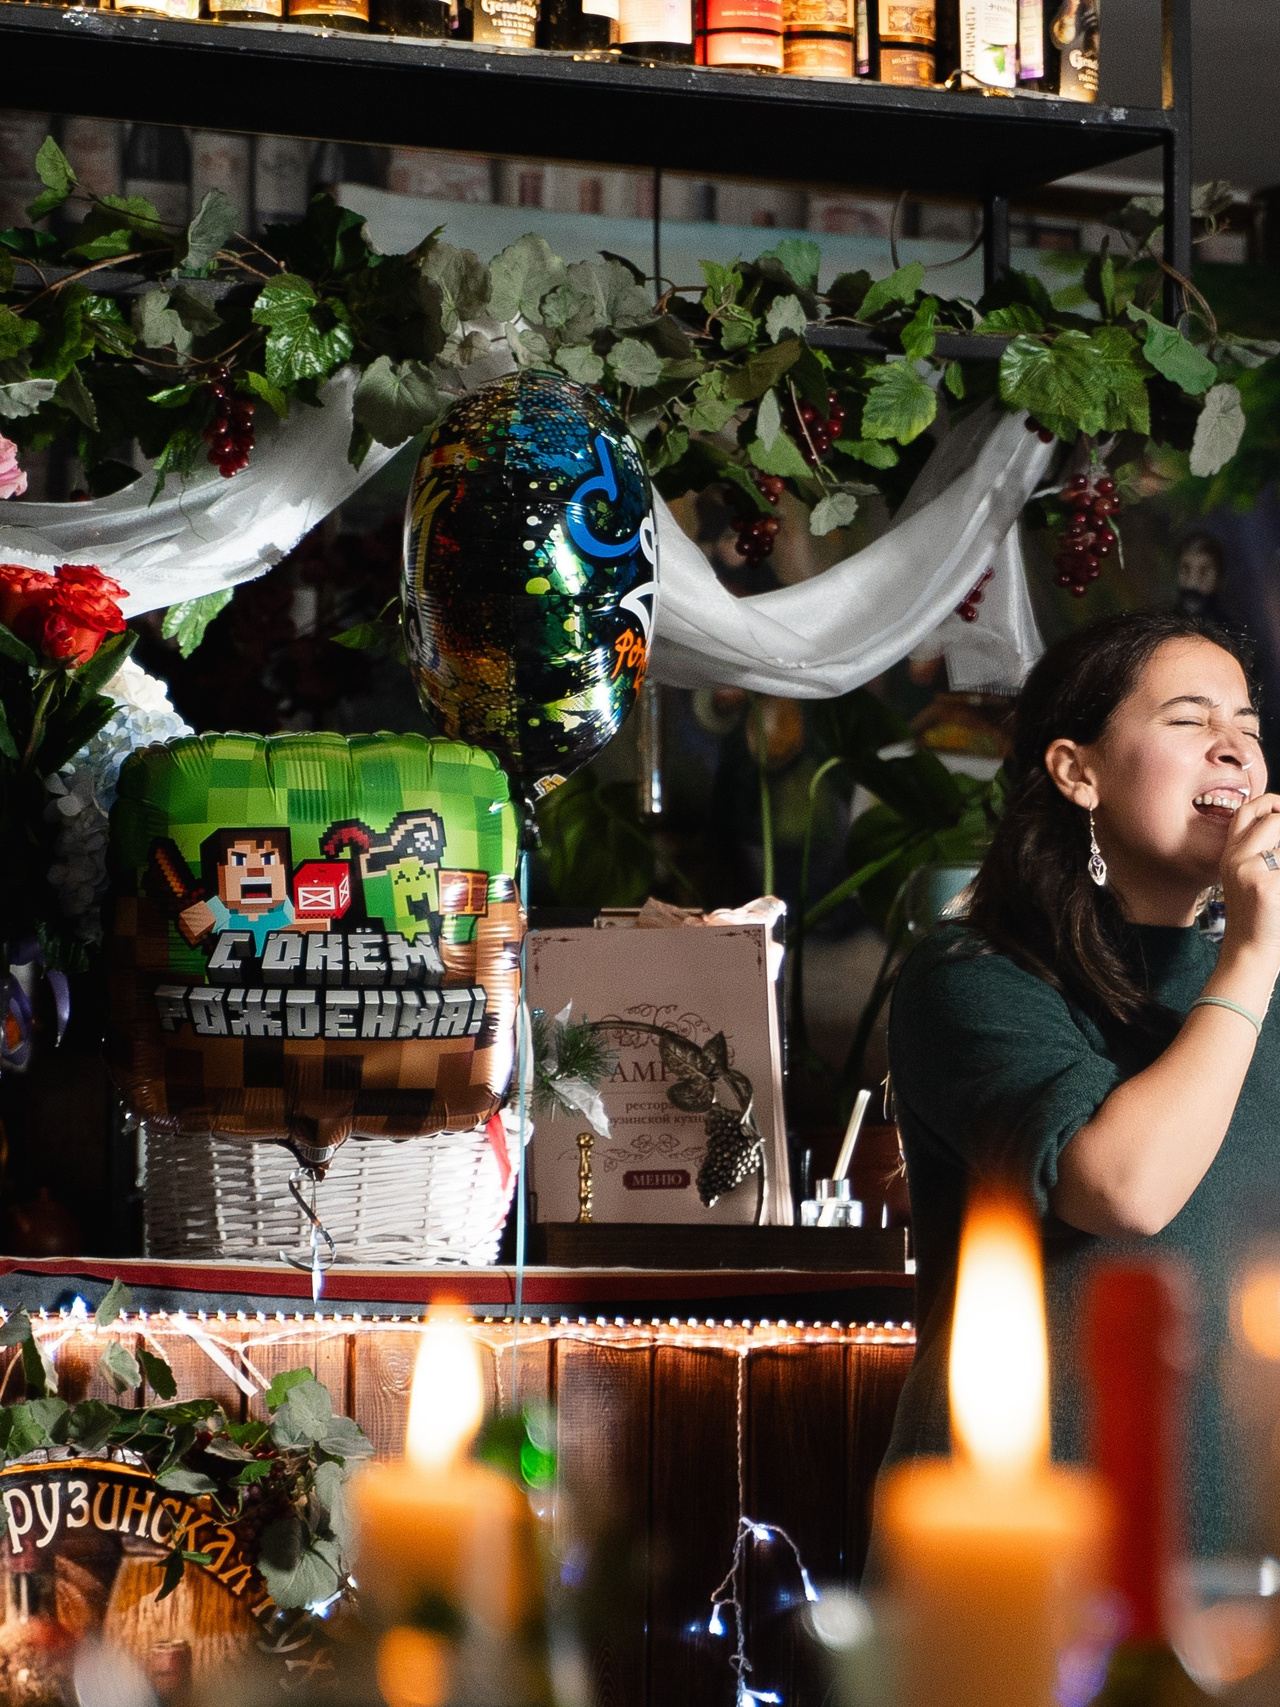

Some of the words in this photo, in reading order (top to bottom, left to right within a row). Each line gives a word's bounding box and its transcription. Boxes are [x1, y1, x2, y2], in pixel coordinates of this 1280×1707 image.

[208, 932, 250, 984] С
[154, 986, 488, 1038] РОЖДЕНИЯ!
[625, 1101, 674, 1114] рестор
[673, 1115, 704, 1127] кухн
[632, 1174, 682, 1186] МЕНЮ
[2, 1480, 252, 1596] рузинская
